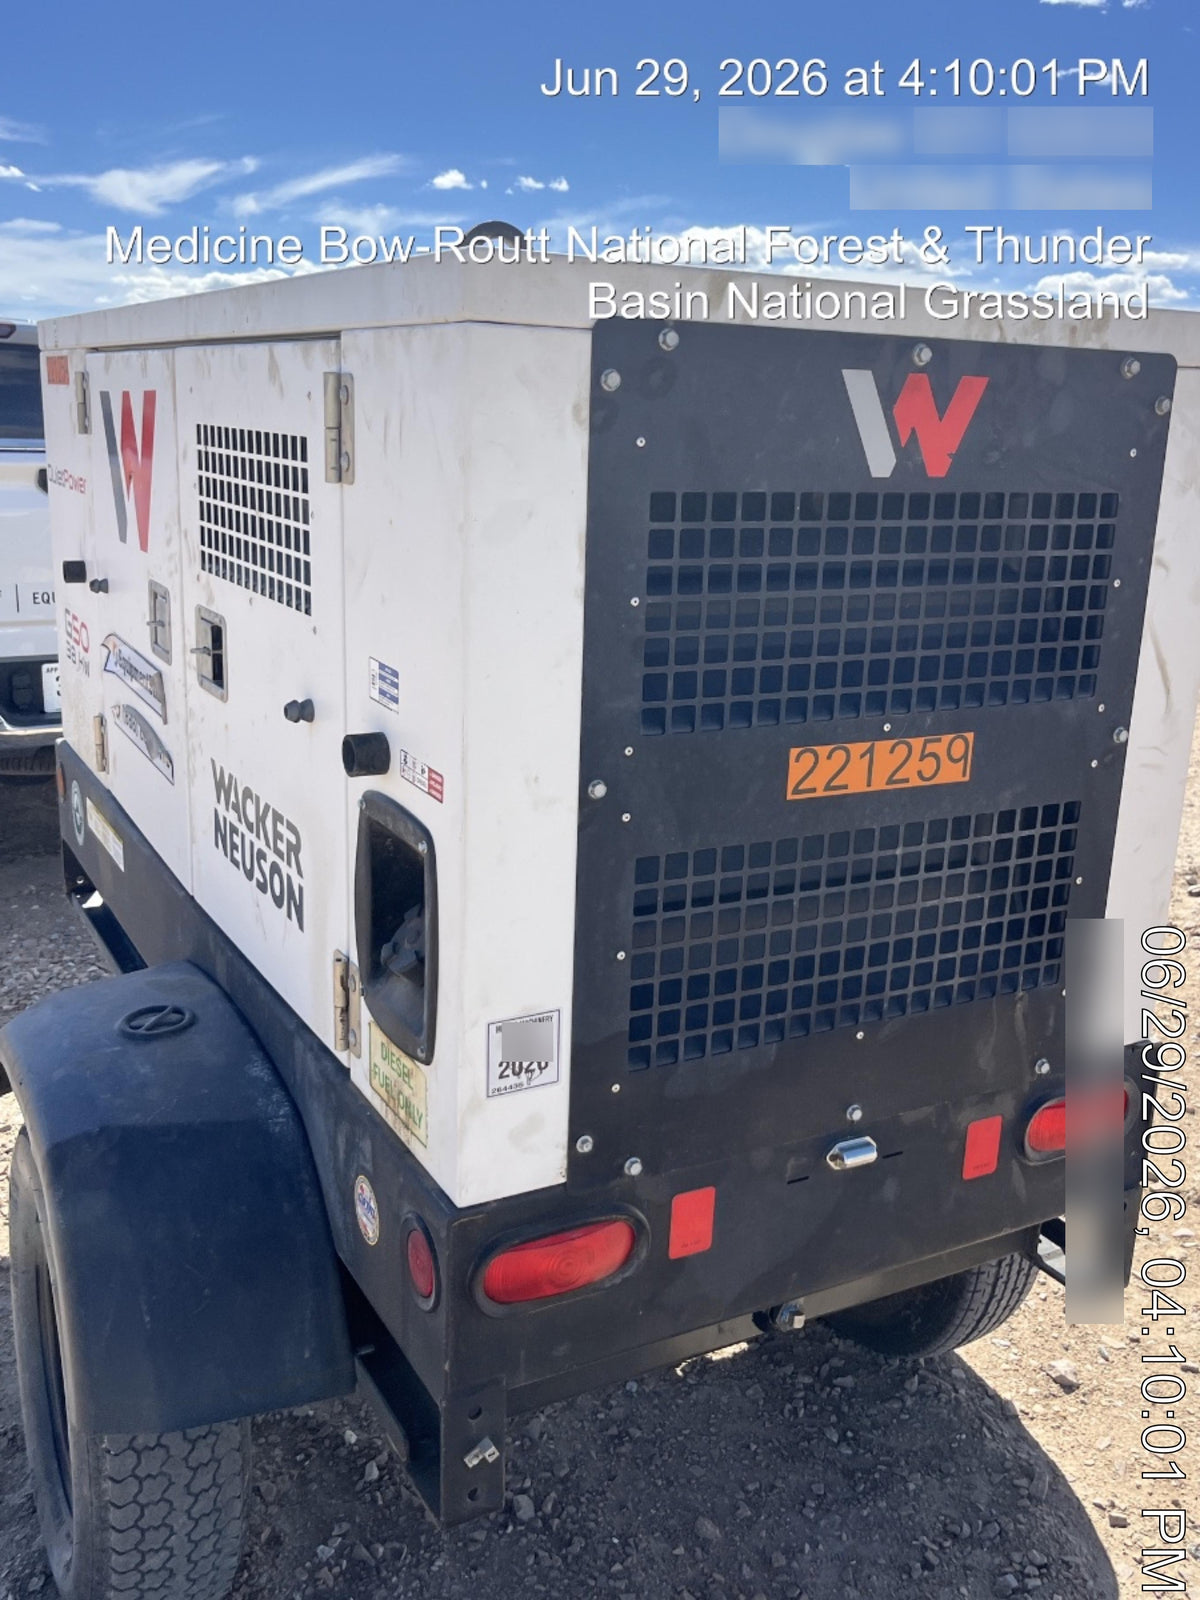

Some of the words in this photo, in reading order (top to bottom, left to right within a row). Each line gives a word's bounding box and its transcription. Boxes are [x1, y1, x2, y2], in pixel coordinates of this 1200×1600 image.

[791, 734, 970, 796] 221259
[210, 756, 304, 879] WACKER
[214, 806, 304, 933] NEUSON
[373, 1061, 395, 1099] FUEL
[397, 1087, 424, 1129] ONLY
[380, 1040, 414, 1091] DIESEL
